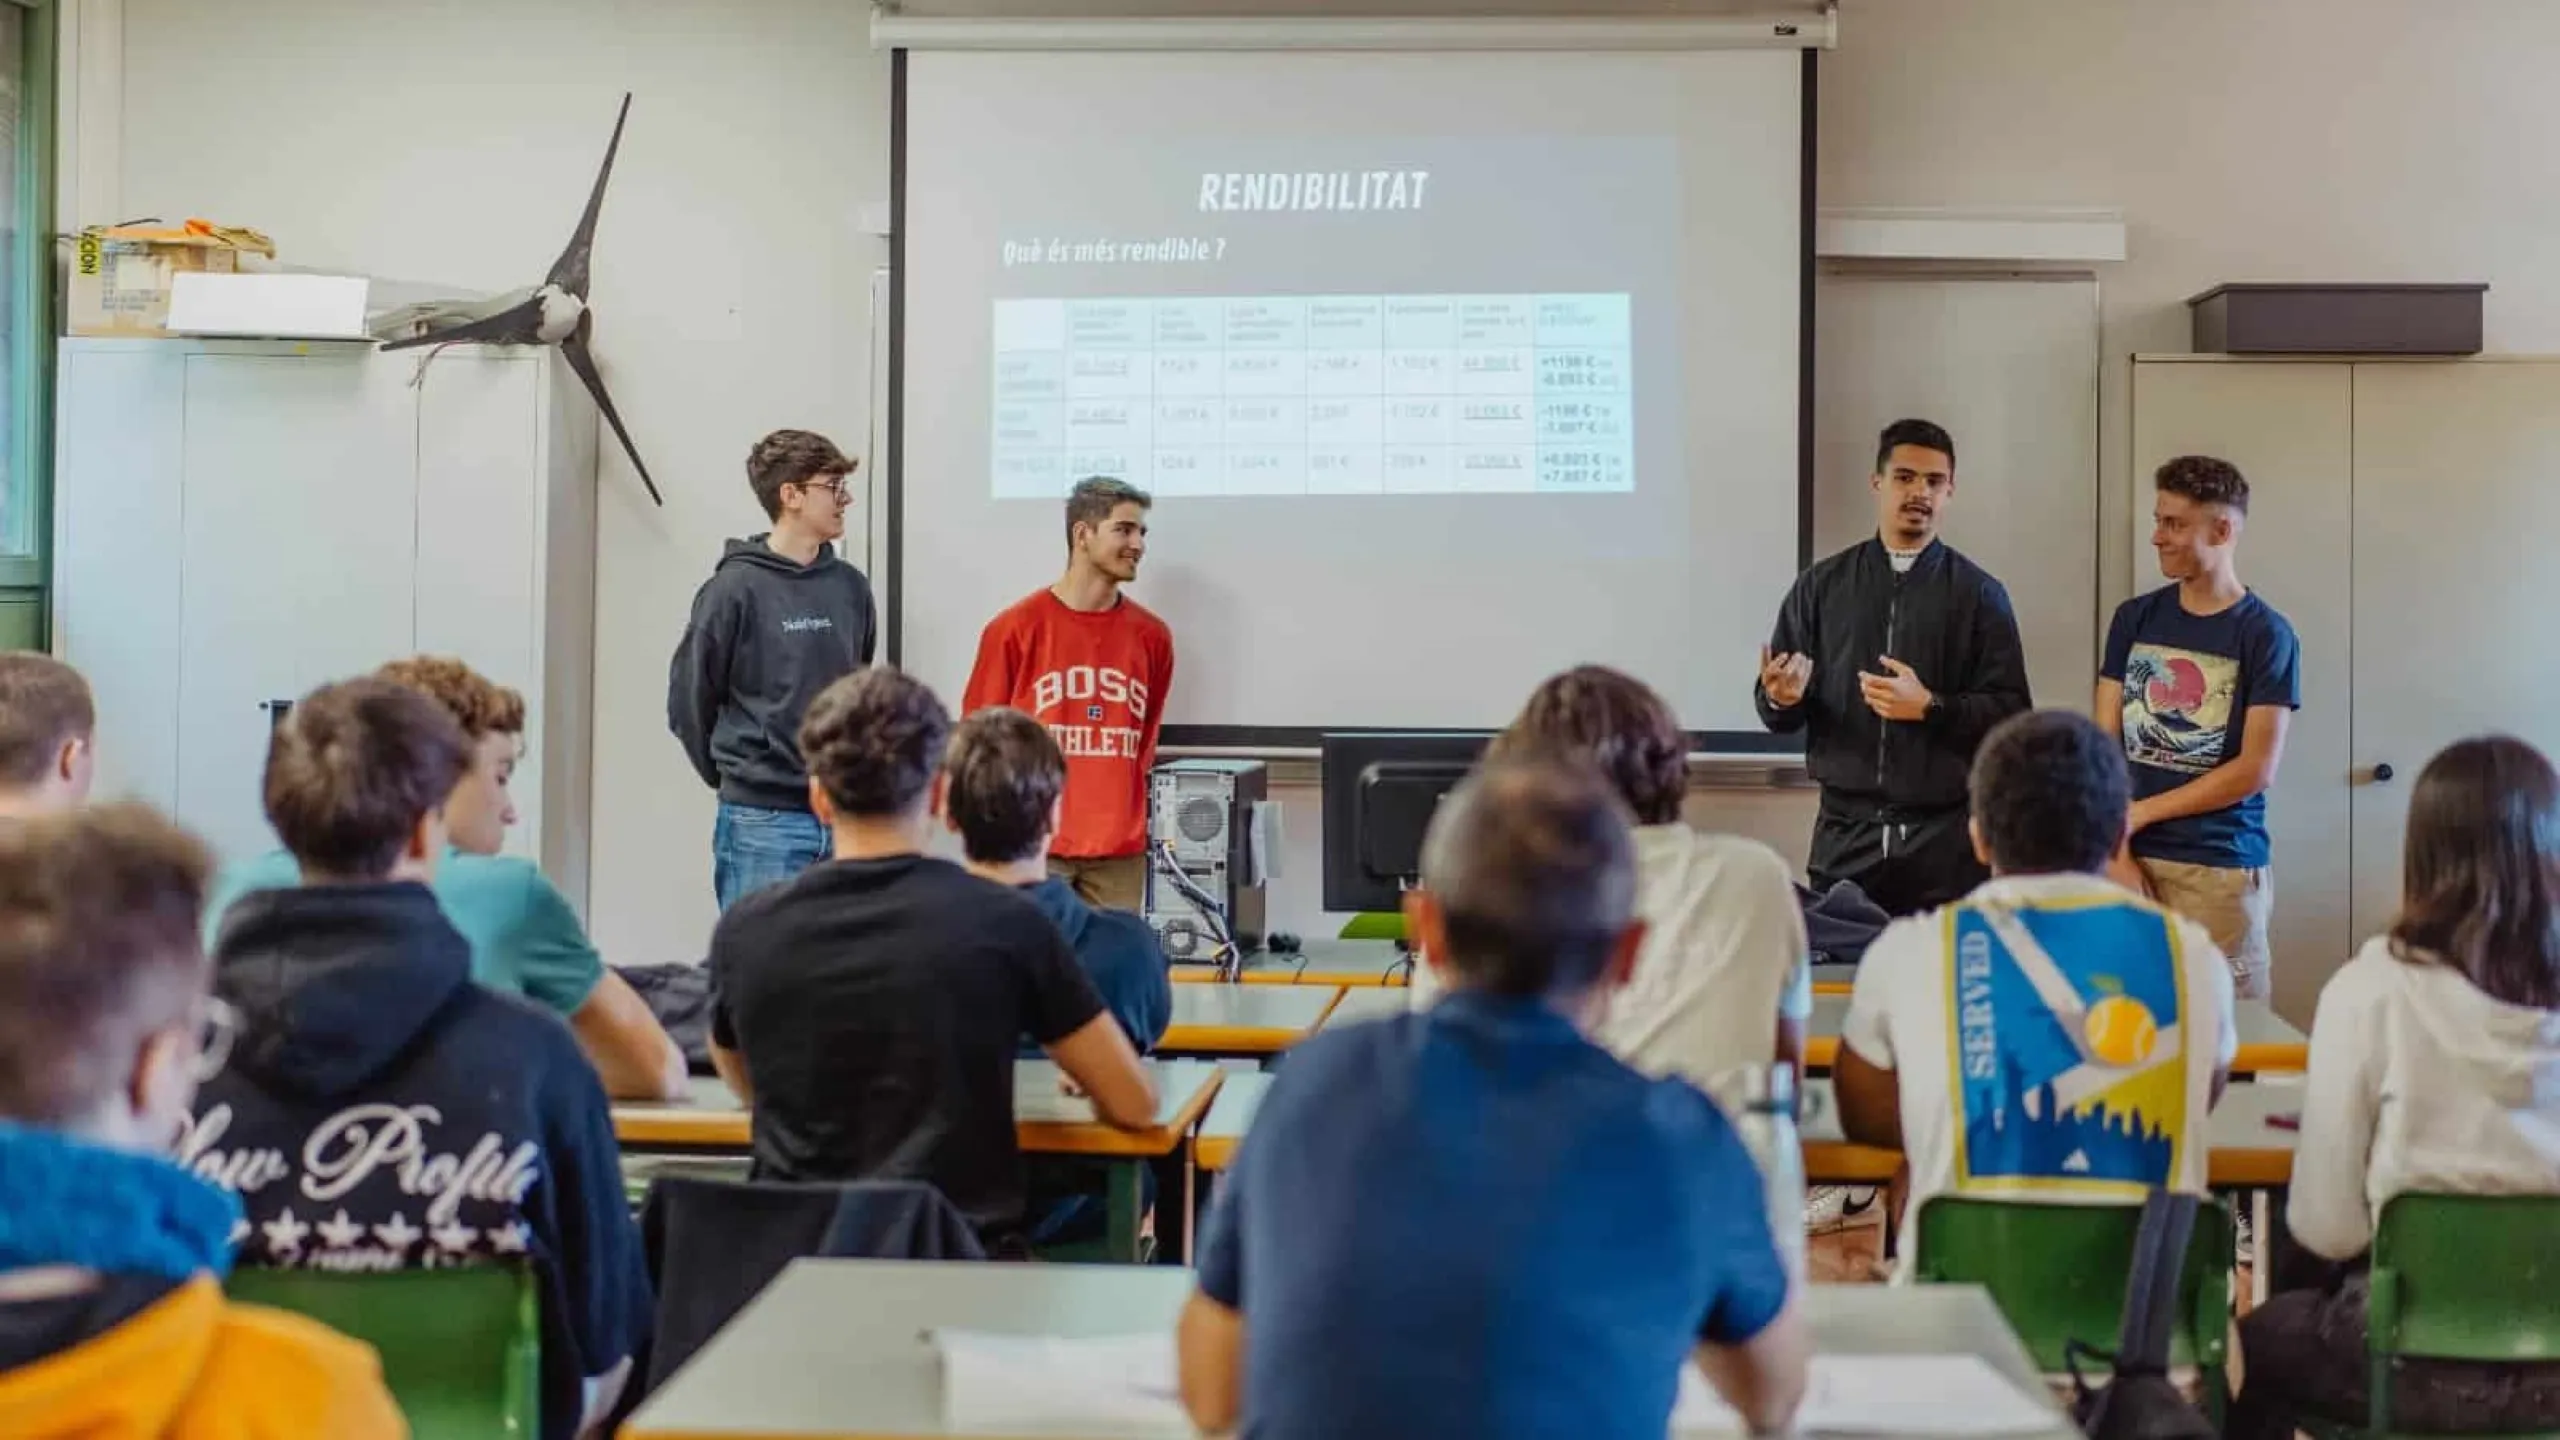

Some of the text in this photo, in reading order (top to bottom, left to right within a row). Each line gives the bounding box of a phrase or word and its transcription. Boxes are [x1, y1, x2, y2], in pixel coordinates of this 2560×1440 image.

[1199, 171, 1429, 211] RENDIBILITAT
[1003, 237, 1042, 267] Què
[1074, 237, 1115, 262] més
[1121, 237, 1210, 261] rendible
[1216, 237, 1226, 260] ?
[1033, 665, 1148, 721] BOSS
[1960, 931, 1995, 1079] SERVED
